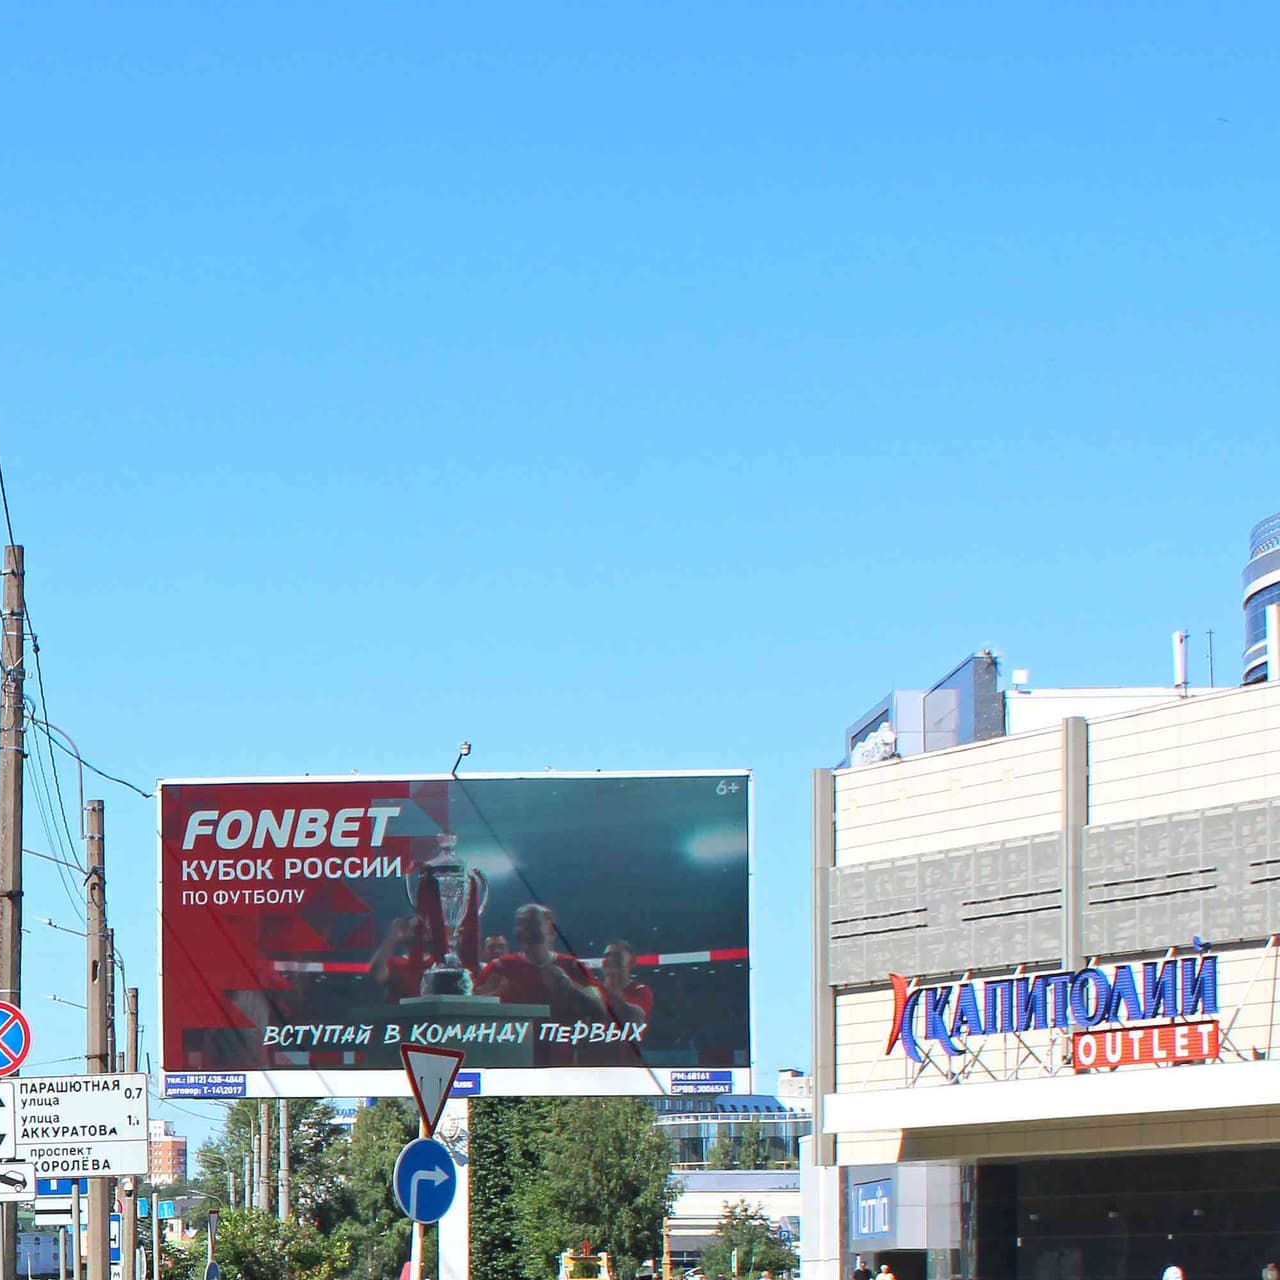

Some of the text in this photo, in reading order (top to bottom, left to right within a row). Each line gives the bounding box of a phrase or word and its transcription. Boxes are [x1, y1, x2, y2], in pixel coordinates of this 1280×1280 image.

[716, 780, 740, 795] 6+
[182, 807, 401, 850] FONBET
[182, 856, 402, 881] КУБОК РОССИИ
[182, 889, 305, 905] ПО ФУТБОЛУ
[924, 936, 1219, 1056] КАПИТОЛИЙ
[263, 1020, 648, 1046] ВСТУПАЙ В КОМАНДУ ПЕРВЫХ
[1078, 1024, 1214, 1066] OUTLET
[20, 1079, 120, 1094] ПАРАШЮТНАЯ
[21, 1096, 60, 1109] улица
[21, 1113, 60, 1126] улица
[21, 1124, 118, 1139] АККУРАТОВА
[30, 1146, 93, 1160] проспект
